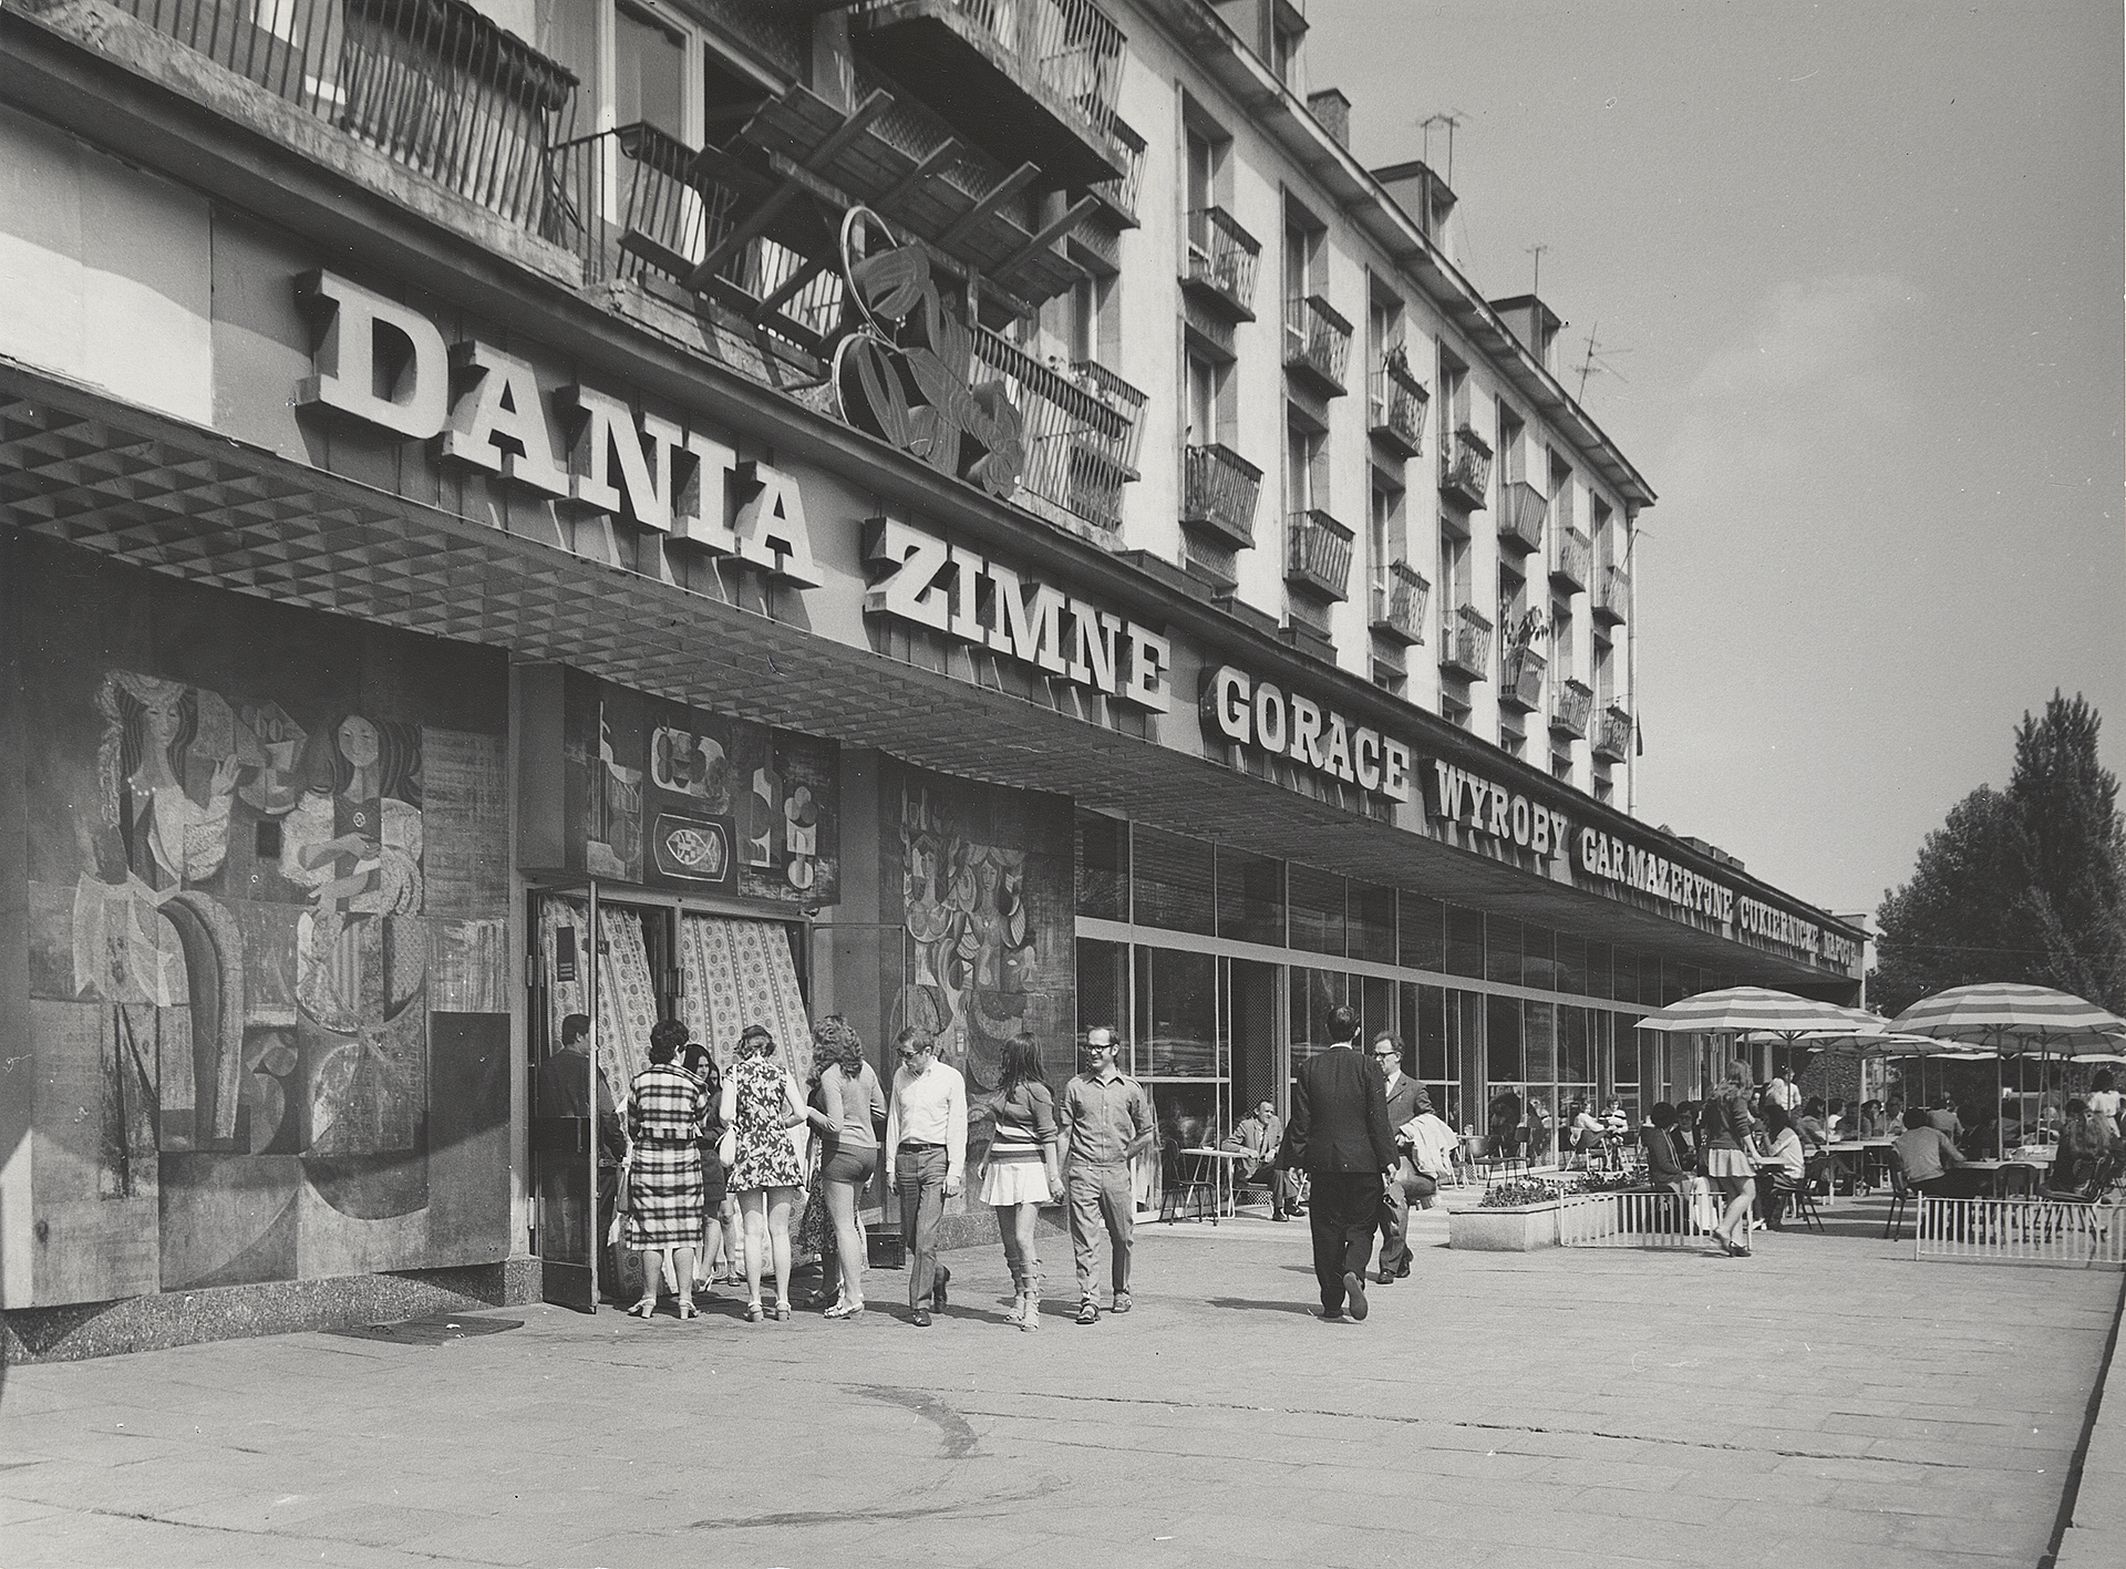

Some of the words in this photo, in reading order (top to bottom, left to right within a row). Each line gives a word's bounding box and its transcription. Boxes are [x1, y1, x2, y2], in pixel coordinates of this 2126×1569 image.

[320, 268, 824, 590] DANIA
[884, 516, 1171, 714] ZIMNE
[1216, 664, 1410, 803] GORACE
[1434, 757, 1568, 860] WYROBY
[1581, 826, 1734, 924] GARMAZERYJNE
[1740, 894, 1819, 954] CUKIERNICZE
